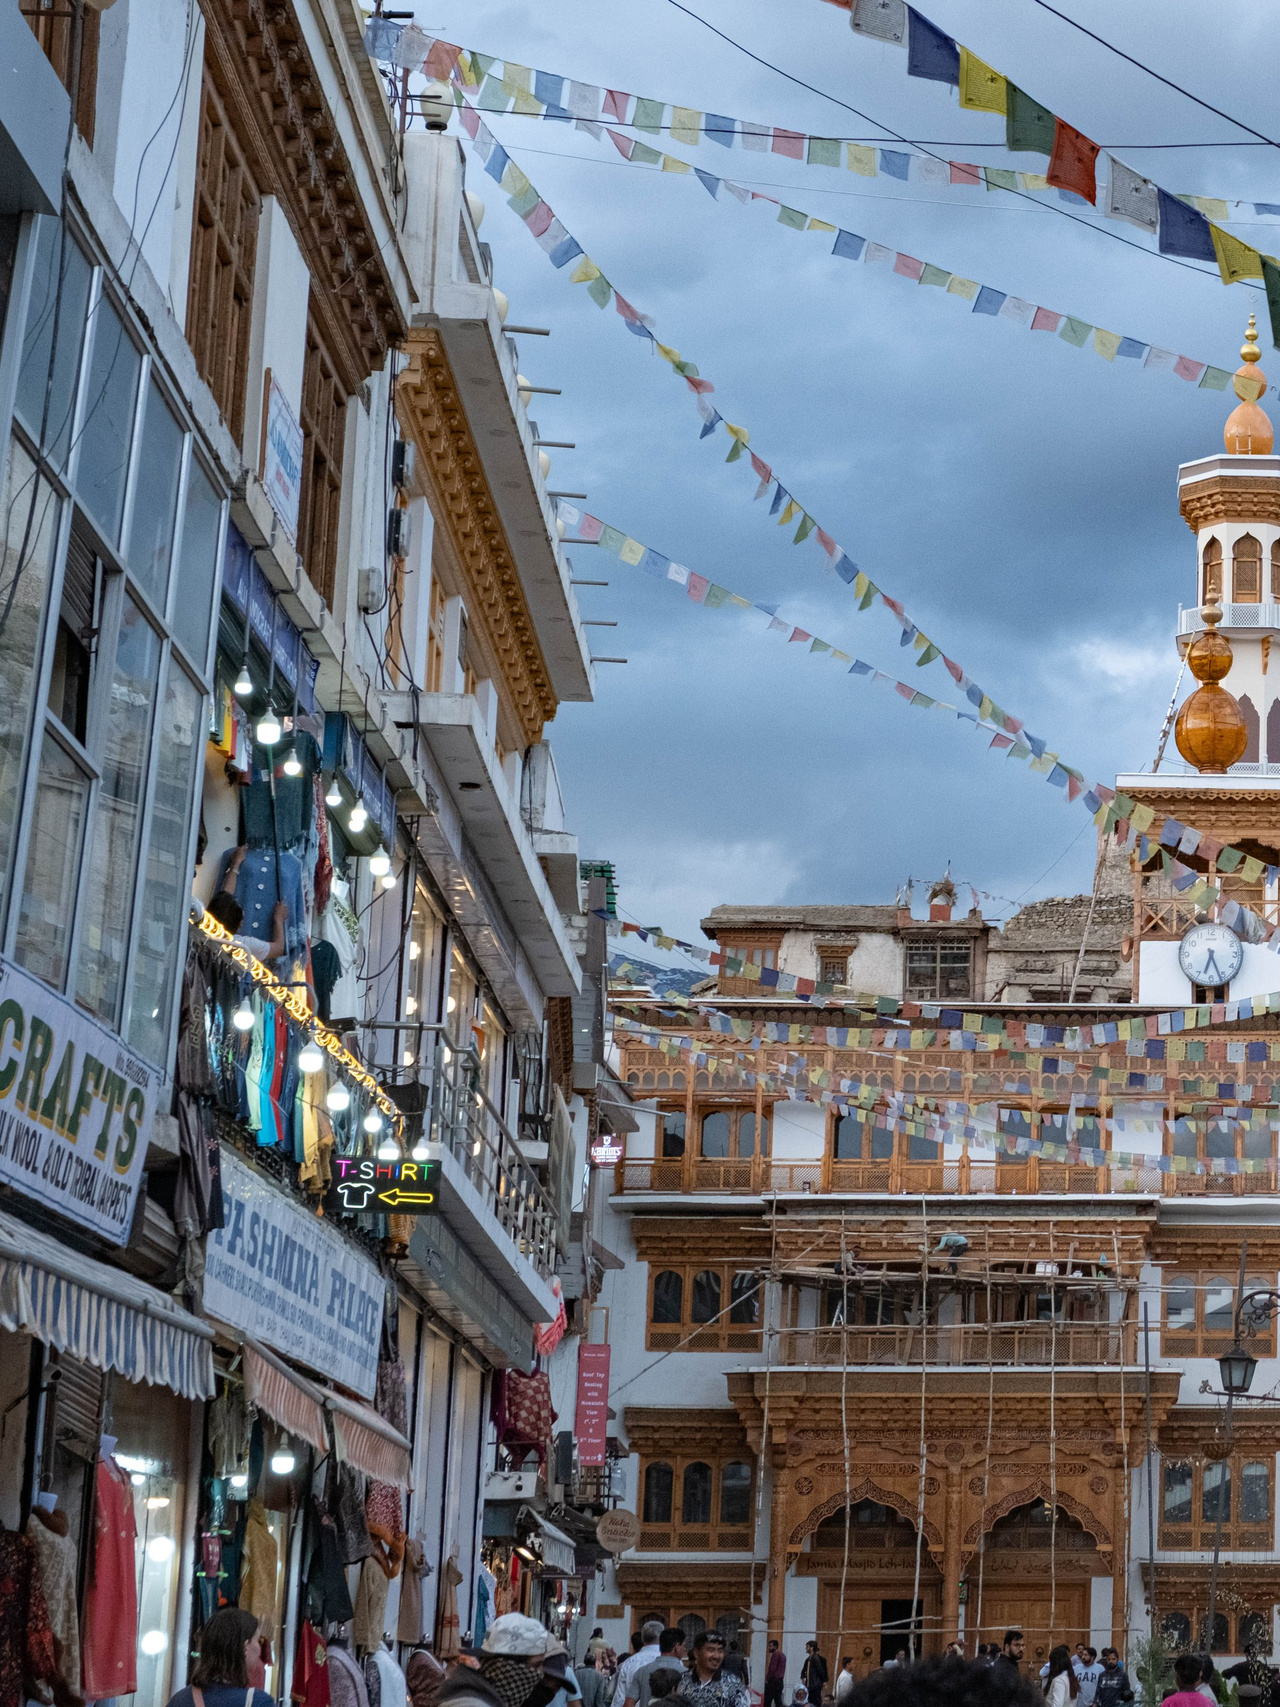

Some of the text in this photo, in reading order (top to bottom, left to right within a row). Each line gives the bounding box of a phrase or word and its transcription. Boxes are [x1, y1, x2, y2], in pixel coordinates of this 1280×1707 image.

[1229, 940, 1235, 948] 2
[1187, 962, 1193, 970] 8
[1208, 974, 1215, 982] 6
[0, 998, 146, 1175] CRAFTS
[11, 1119, 42, 1175] WOOL
[50, 1144, 73, 1191] OLD
[69, 1155, 101, 1208] TRIBAL
[335, 1159, 434, 1181] T-SHIRT
[215, 1190, 319, 1308] PASHMINA
[325, 1267, 379, 1347] PALACE
[806, 1558, 837, 1570] Jamia
[1077, 1672, 1097, 1682] GAP
